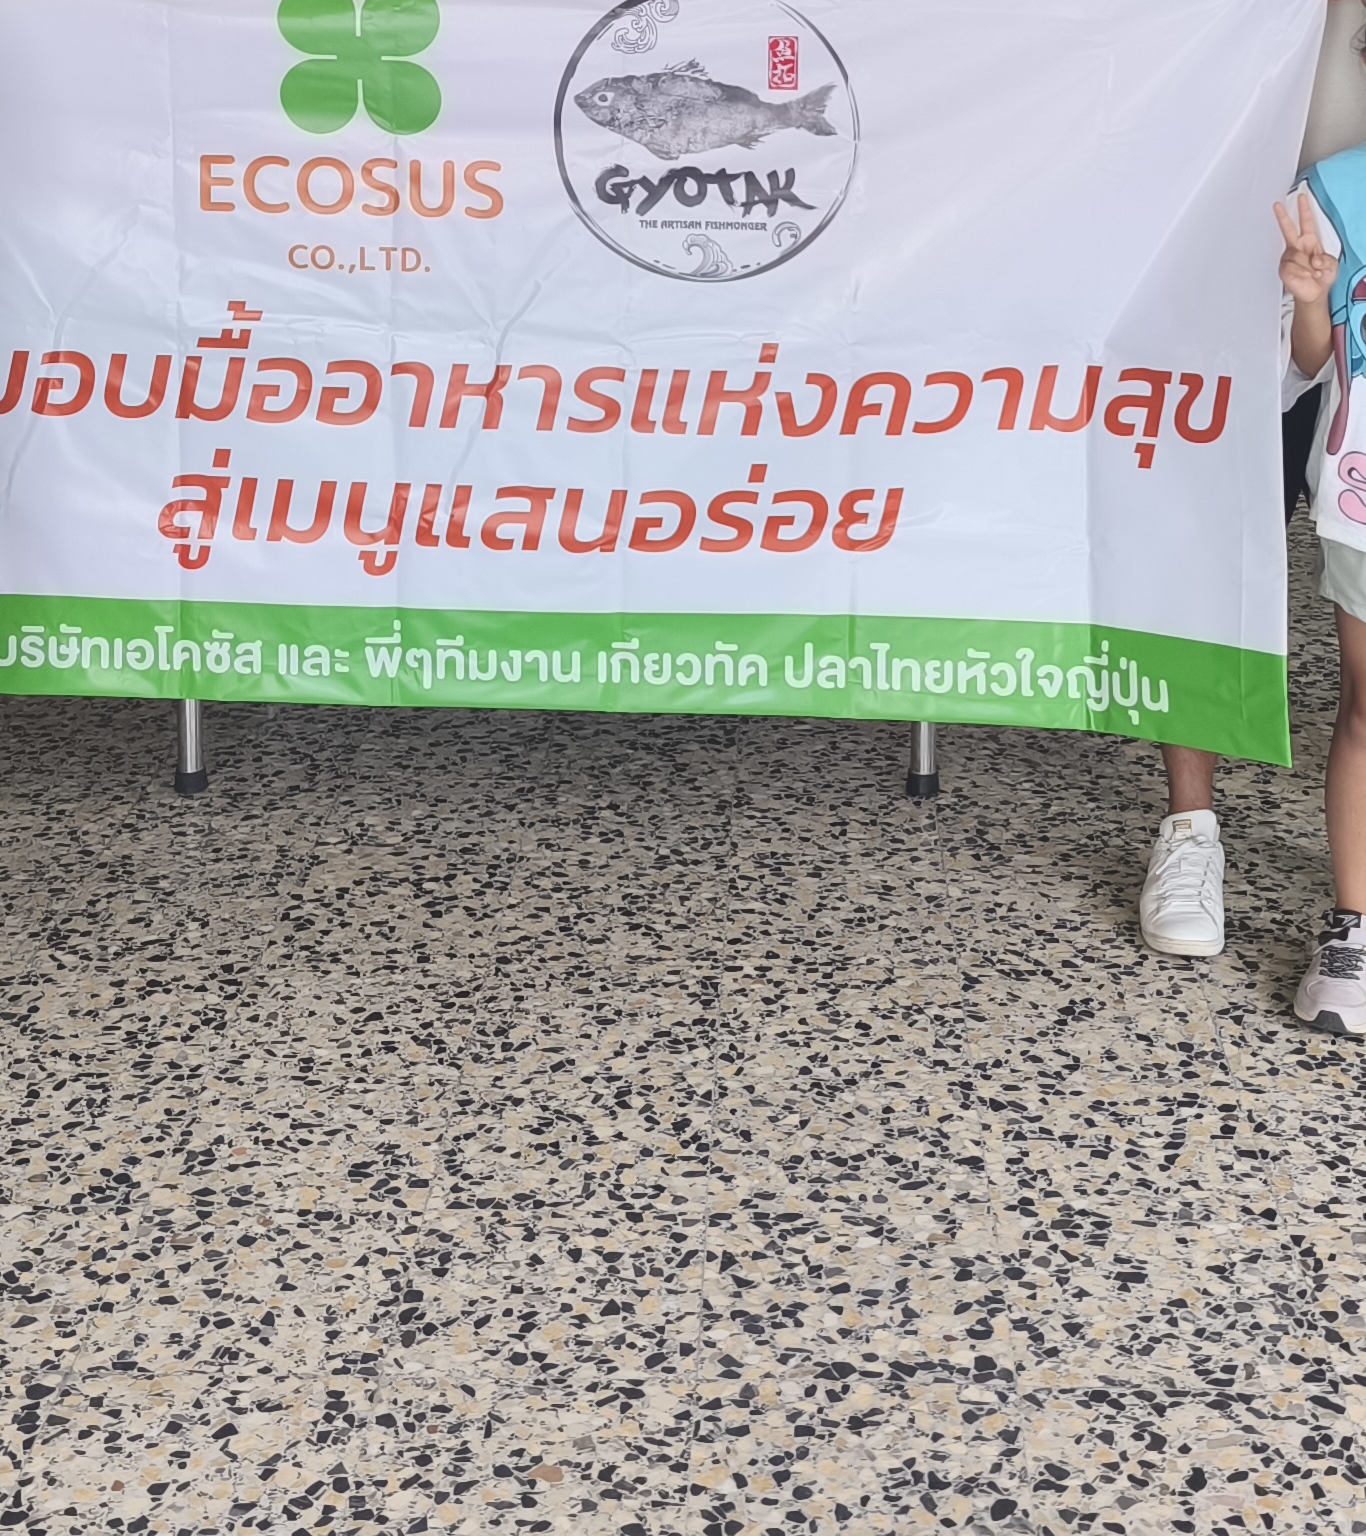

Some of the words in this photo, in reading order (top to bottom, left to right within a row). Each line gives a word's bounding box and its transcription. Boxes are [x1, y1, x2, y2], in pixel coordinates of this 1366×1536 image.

[199, 154, 504, 219] ECOSUS
[594, 163, 818, 218] GYOTAK
[639, 219, 658, 230] THE
[660, 220, 702, 230] ARTISAN
[705, 220, 768, 232] FISHMONGER
[288, 244, 431, 274] CO.,LTD.
[157, 448, 904, 577] สู่เมนูแสนอร่อย
[278, 642, 351, 677] และ
[365, 619, 581, 690] พี่ๆทีมงาน
[597, 637, 768, 687] เกียวทัค
[784, 639, 1170, 726] ปลาไทยหัวใจญี่ปุ่น
